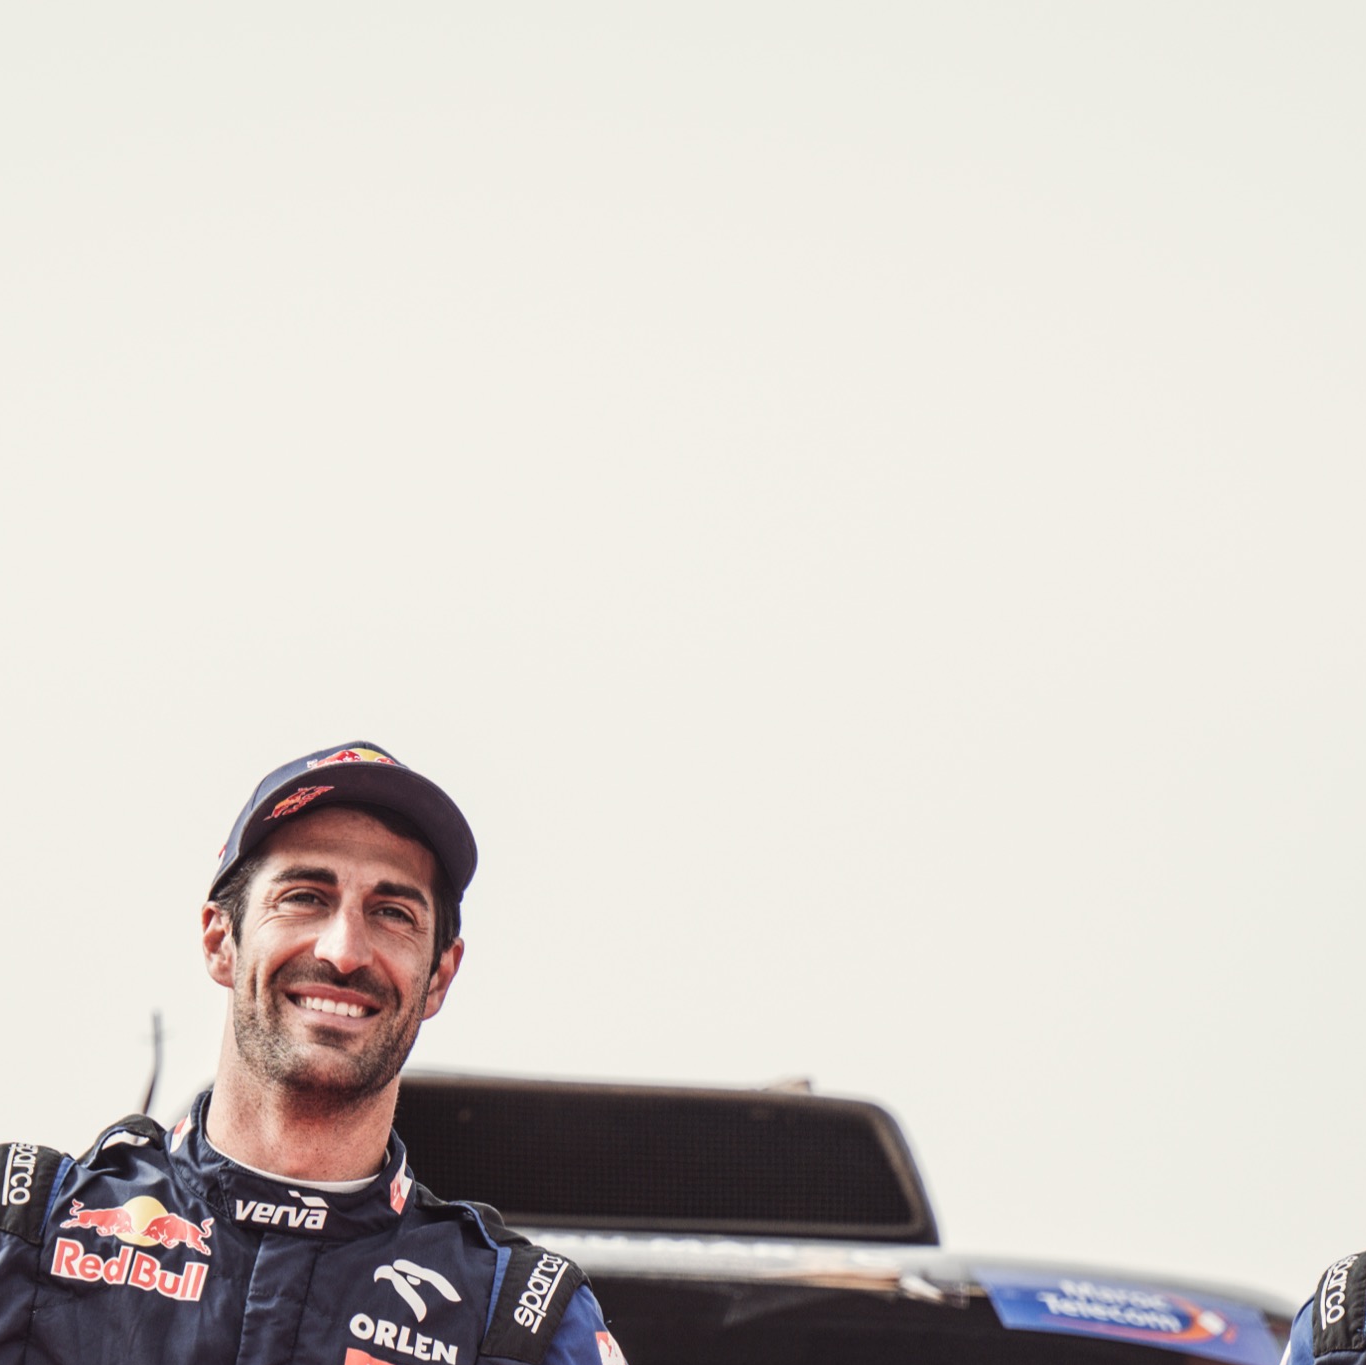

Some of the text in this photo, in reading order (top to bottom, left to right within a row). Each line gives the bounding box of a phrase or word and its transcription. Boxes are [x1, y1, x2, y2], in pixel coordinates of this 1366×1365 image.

[235, 1198, 328, 1230] verva
[51, 1237, 209, 1302] Red Bull
[514, 1253, 569, 1334] sparco
[1037, 1291, 1183, 1334] Telecom
